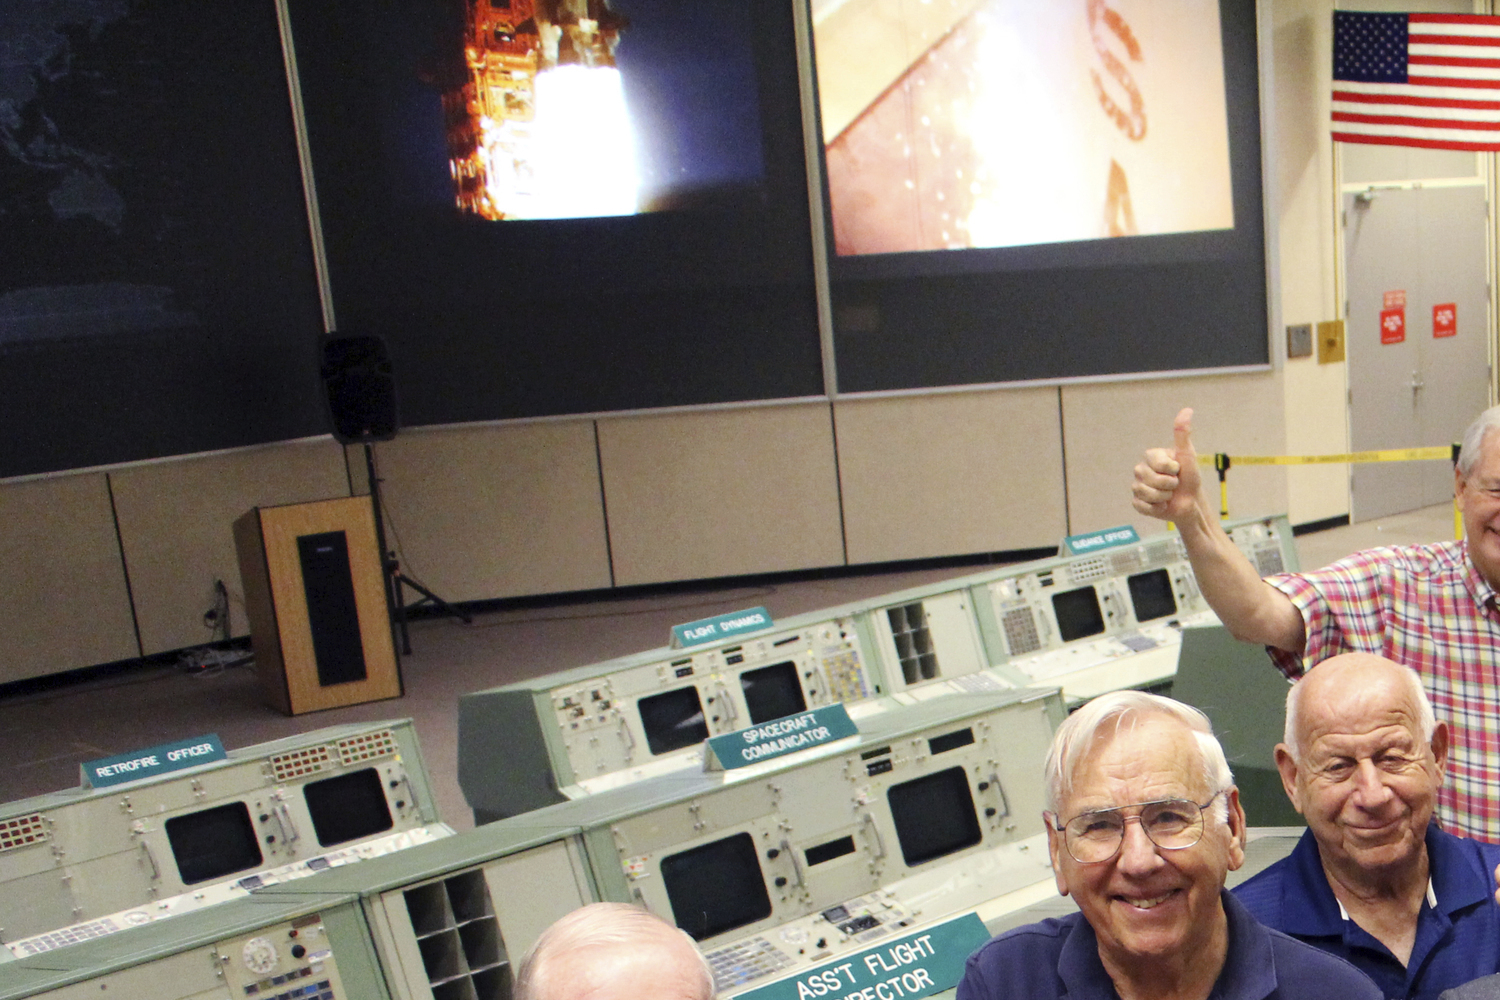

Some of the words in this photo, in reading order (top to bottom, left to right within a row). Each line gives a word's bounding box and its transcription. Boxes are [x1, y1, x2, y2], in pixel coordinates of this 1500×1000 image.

[683, 624, 716, 640] FLIGHT
[719, 613, 766, 632] DYNAMICS
[741, 726, 831, 760] COMMUNICATOR
[742, 713, 818, 743] SPACECRAFT
[96, 755, 160, 778] RETROFIRE
[167, 743, 215, 762] OFFICER
[863, 934, 936, 976] FLIGHT
